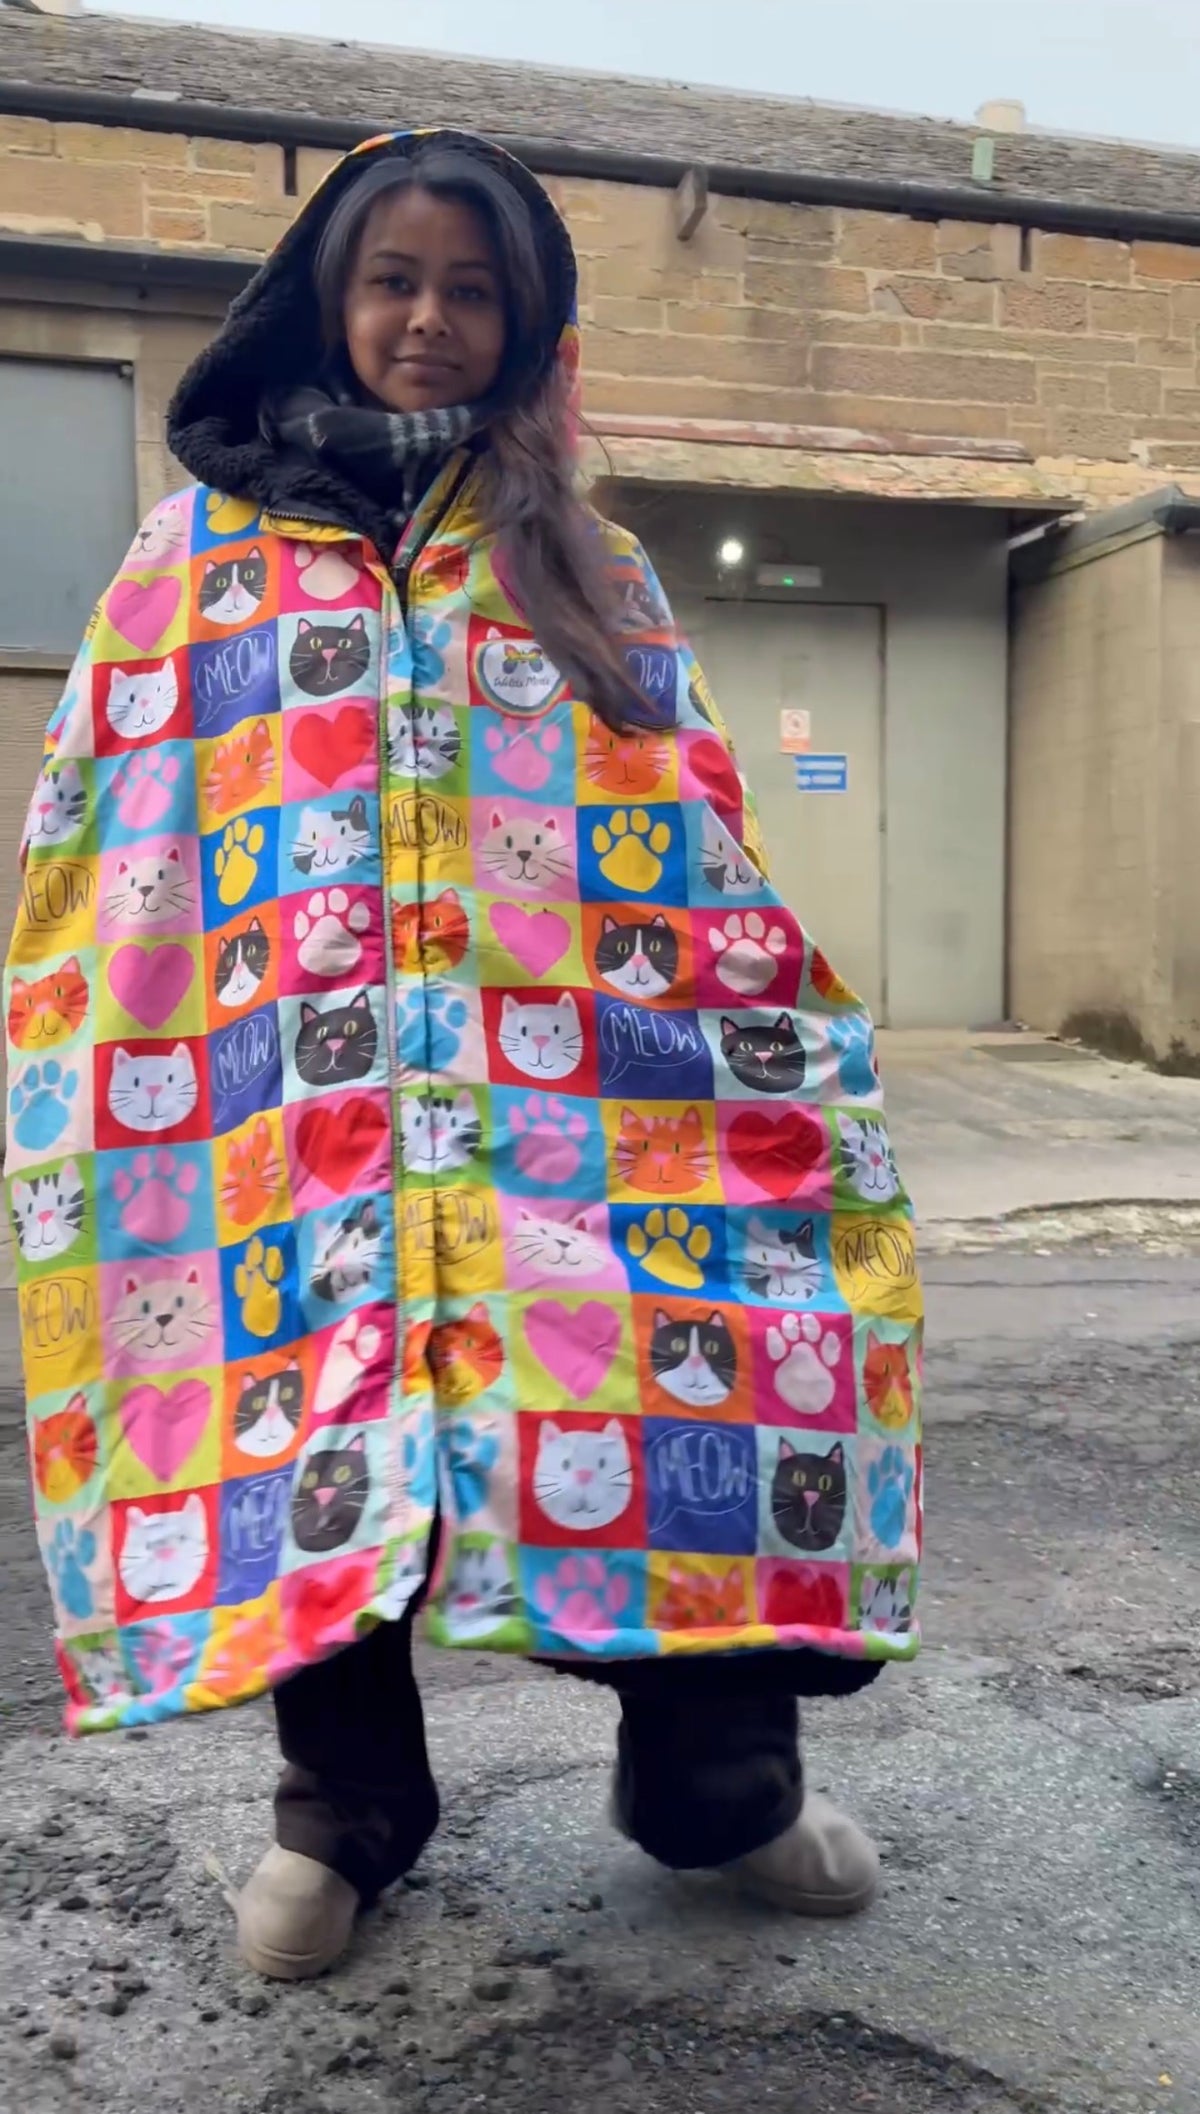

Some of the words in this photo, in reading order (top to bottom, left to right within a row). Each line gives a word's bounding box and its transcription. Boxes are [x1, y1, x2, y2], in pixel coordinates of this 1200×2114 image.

[204, 636, 270, 697] MEOW
[24, 866, 90, 922] EOW
[218, 1021, 270, 1089] MEOW
[610, 1007, 697, 1056] MEOW
[845, 1228, 915, 1279] MEOW
[657, 1432, 748, 1501] MEOW
